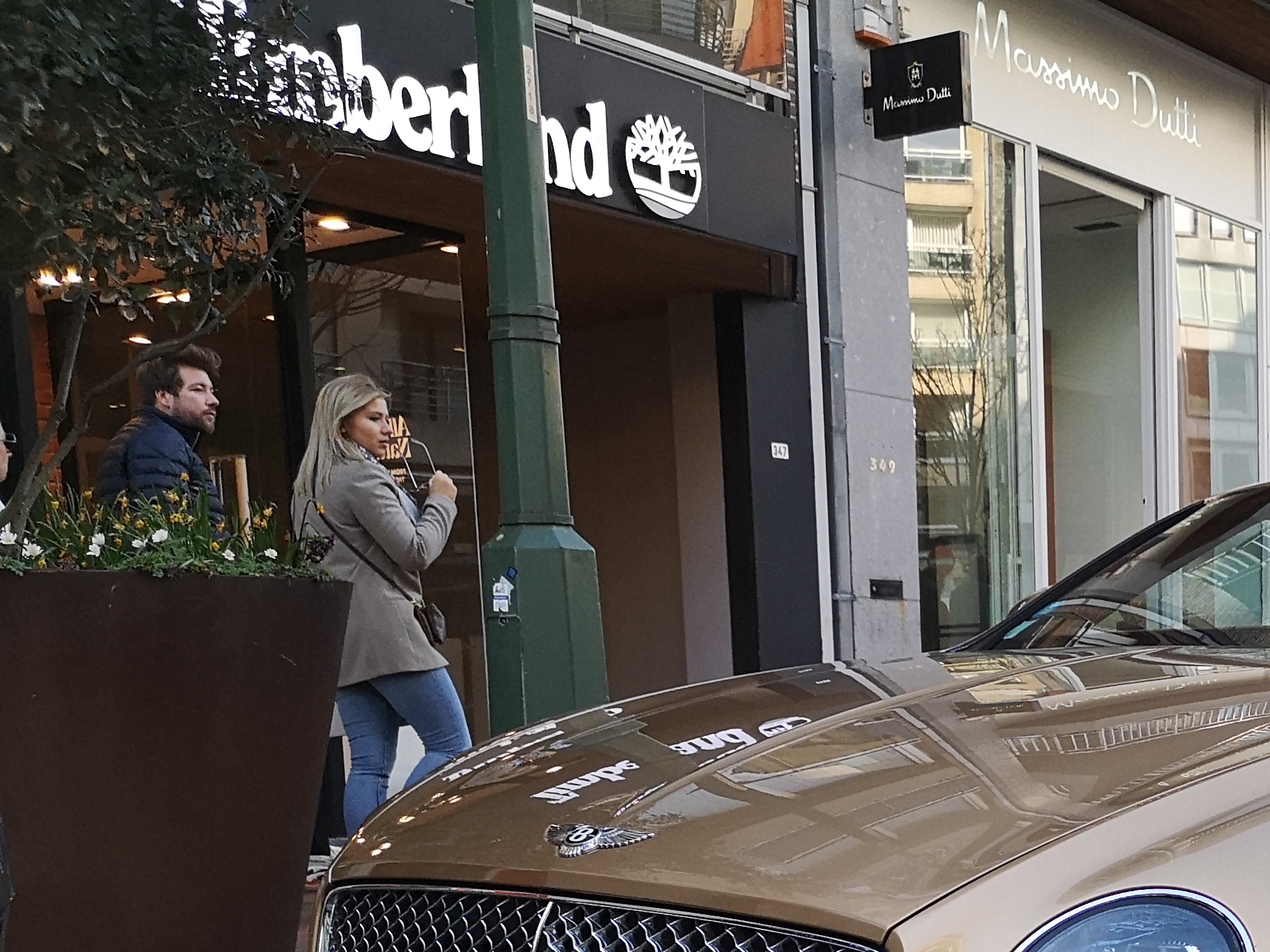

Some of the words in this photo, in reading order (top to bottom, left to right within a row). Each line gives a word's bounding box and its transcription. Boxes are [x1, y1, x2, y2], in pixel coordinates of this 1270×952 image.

[974, 1, 1120, 110] Massimo
[1127, 71, 1202, 147] Dutti
[882, 95, 925, 112] Massimo
[926, 86, 952, 103] Dutti
[773, 444, 787, 458] 347
[869, 456, 896, 474] 349
